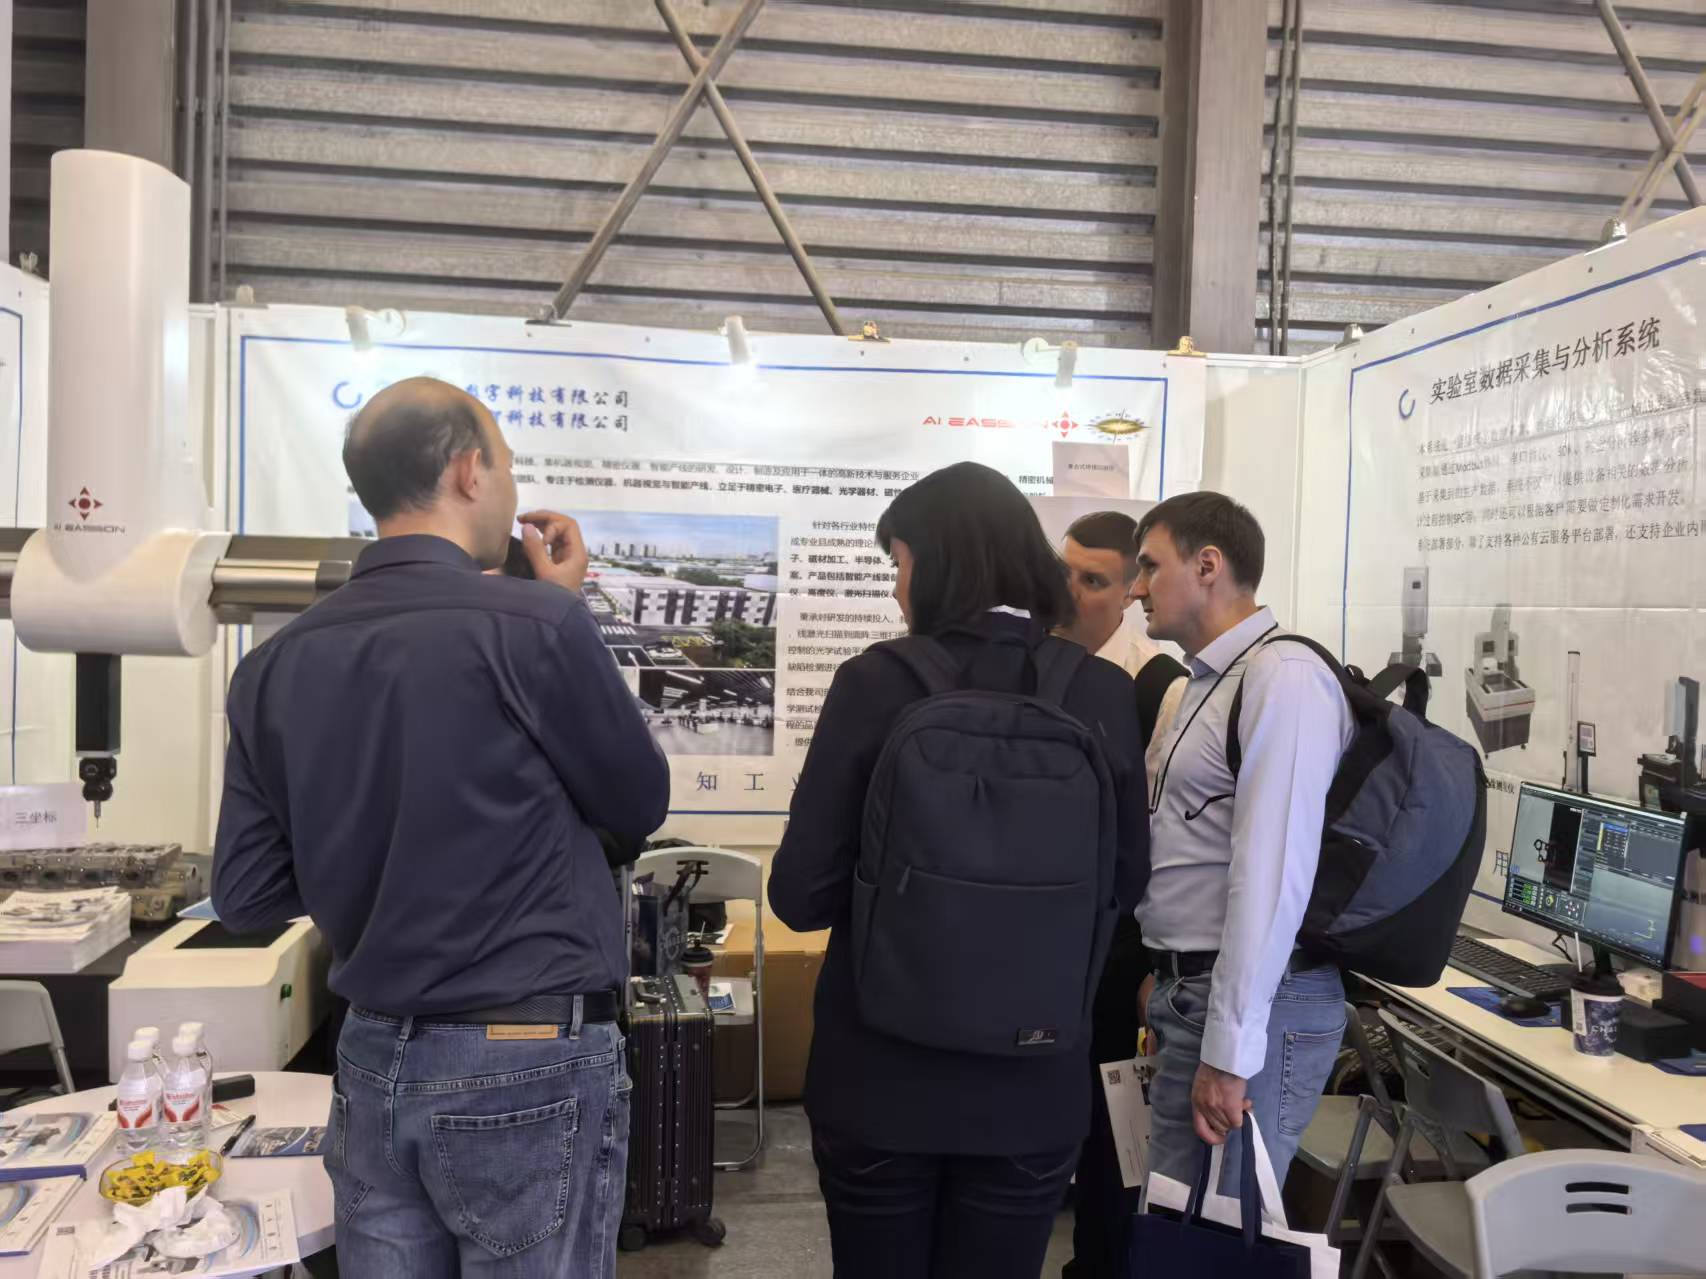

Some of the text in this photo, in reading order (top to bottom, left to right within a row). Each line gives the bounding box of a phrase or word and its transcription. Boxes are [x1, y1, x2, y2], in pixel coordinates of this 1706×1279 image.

[1431, 317, 1661, 405] 实验室数据采集与分析系统
[922, 415, 942, 426] AI
[790, 537, 879, 549] 成专业且成熟的理论
[15, 811, 57, 823] 三坐标
